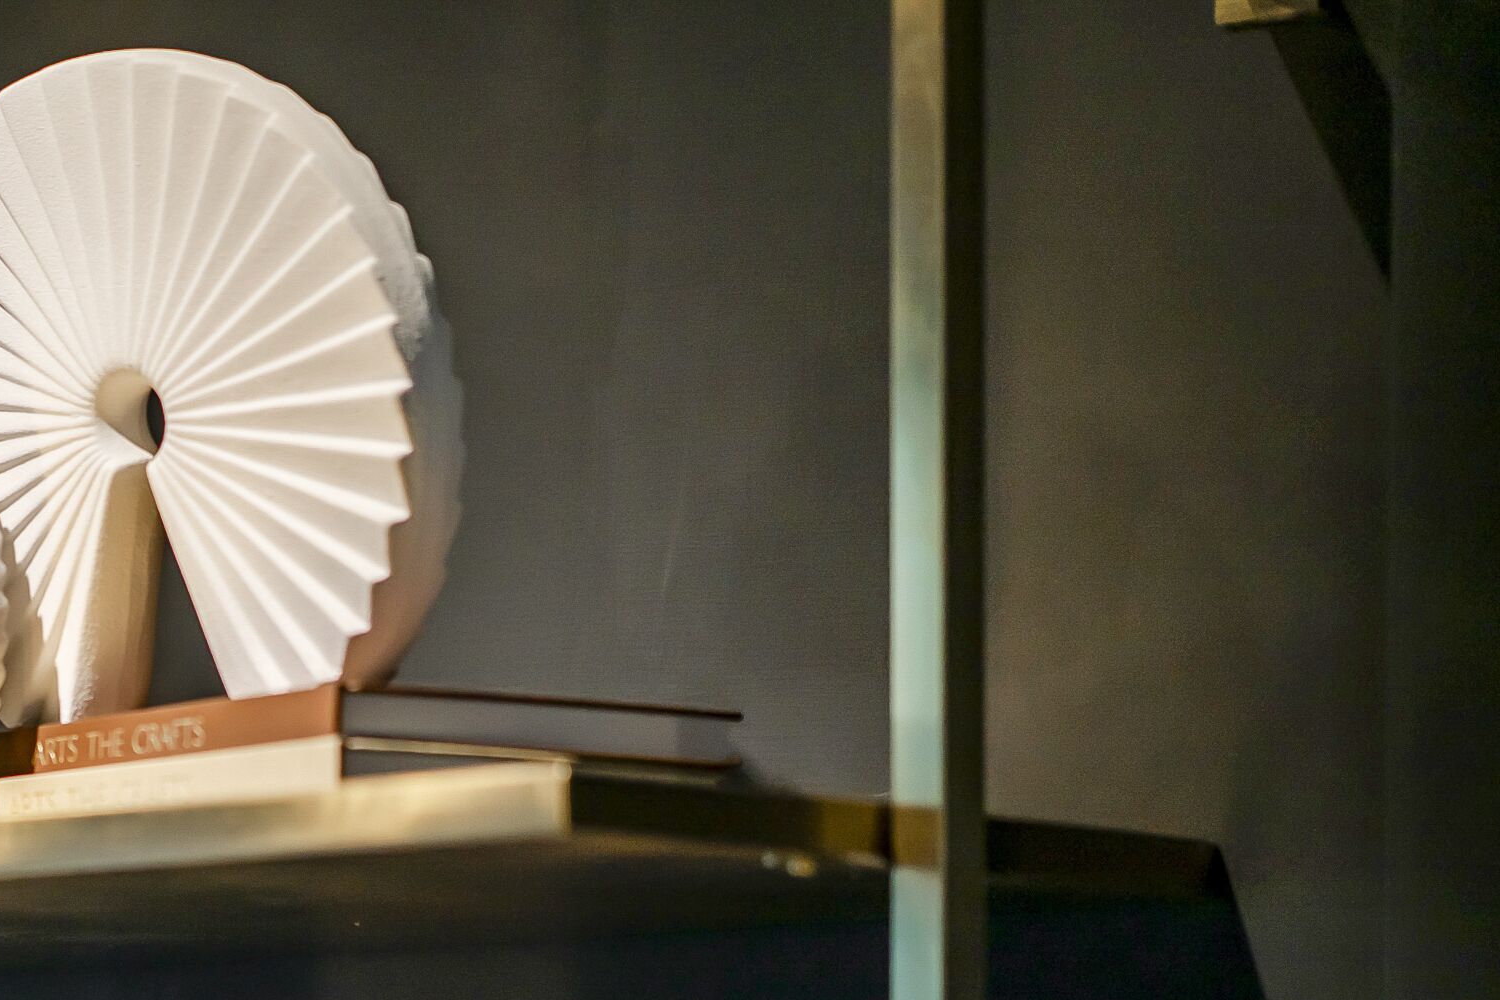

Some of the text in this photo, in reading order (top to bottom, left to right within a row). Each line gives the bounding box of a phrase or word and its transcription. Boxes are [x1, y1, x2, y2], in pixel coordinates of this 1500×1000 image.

[35, 714, 207, 766] ARTS THE CRAFTS
